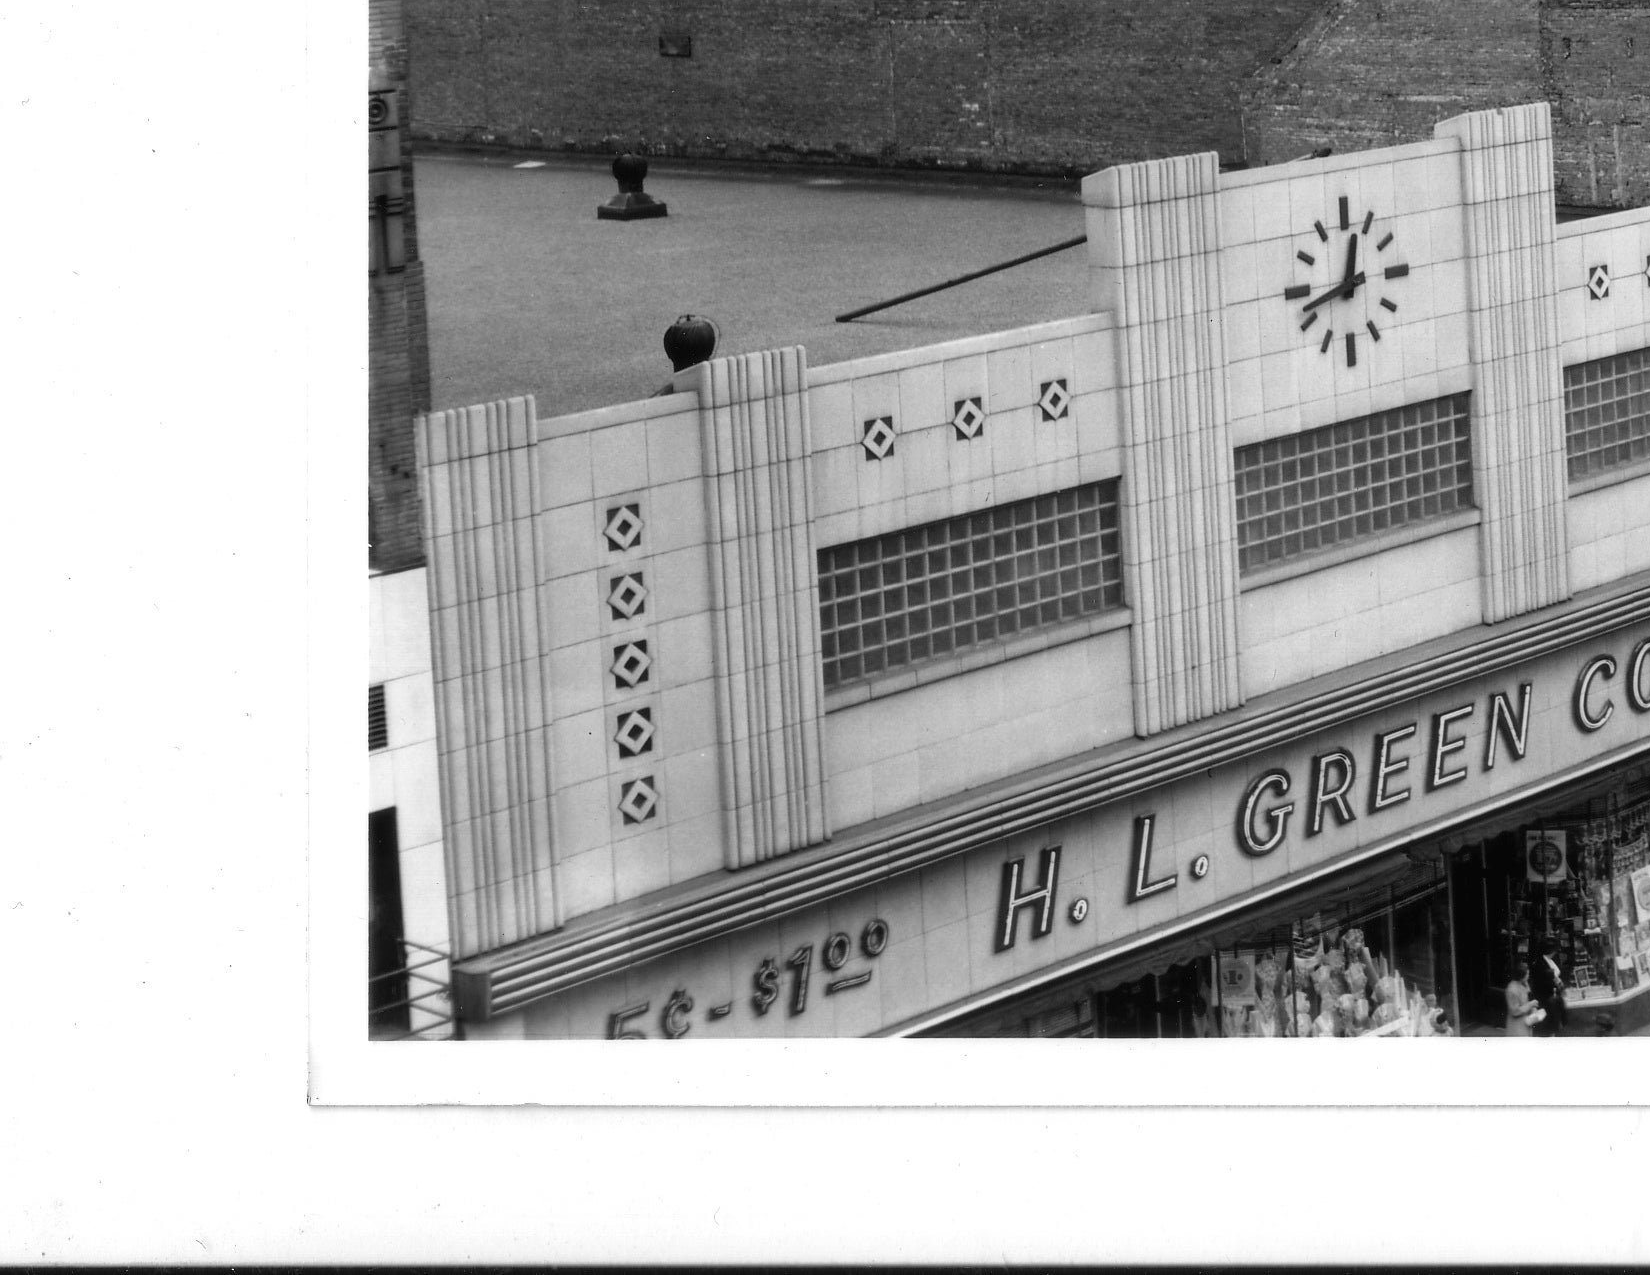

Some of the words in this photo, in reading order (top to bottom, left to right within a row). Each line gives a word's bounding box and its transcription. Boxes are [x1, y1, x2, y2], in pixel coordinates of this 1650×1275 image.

[996, 846, 1089, 953] H.
[1128, 813, 1210, 903] L.
[1236, 683, 1533, 856] GREEN
